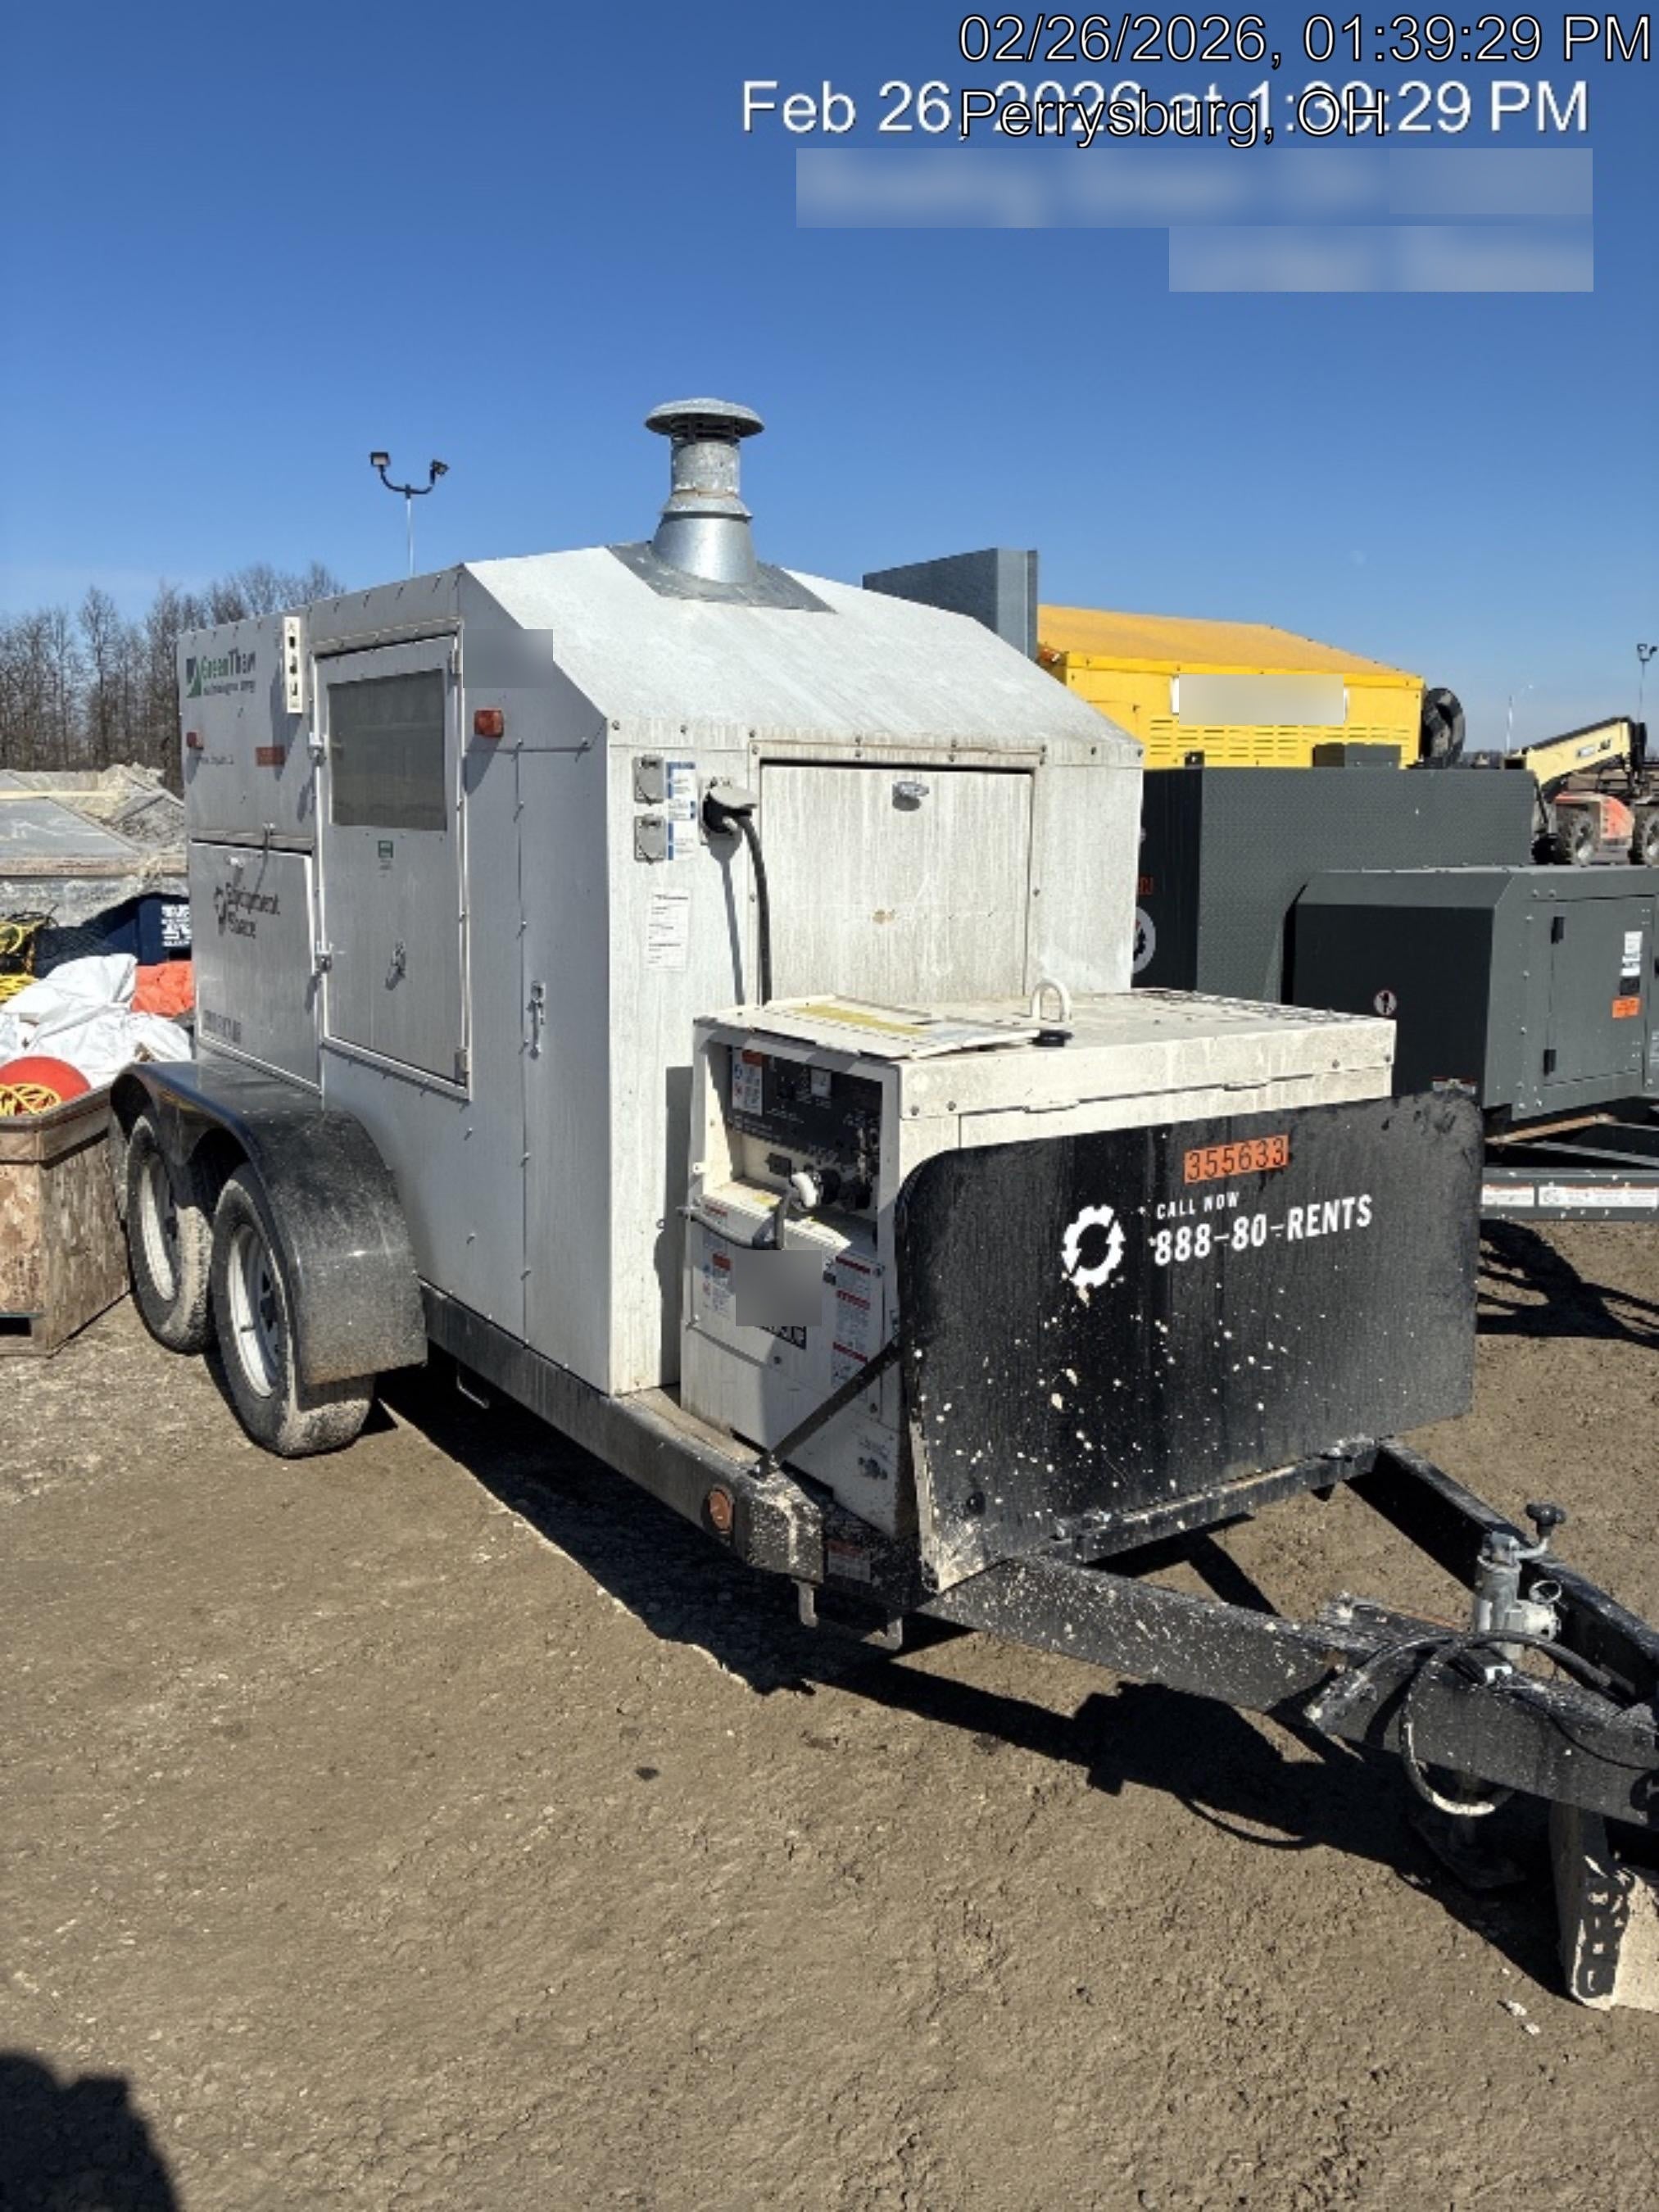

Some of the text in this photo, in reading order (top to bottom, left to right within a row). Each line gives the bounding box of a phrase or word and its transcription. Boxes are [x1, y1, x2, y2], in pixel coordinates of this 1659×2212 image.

[1186, 1136, 1286, 1181] 355633
[1156, 1190, 1240, 1220] CALL NOW
[1154, 1194, 1373, 1267] 888-80-RENTS
